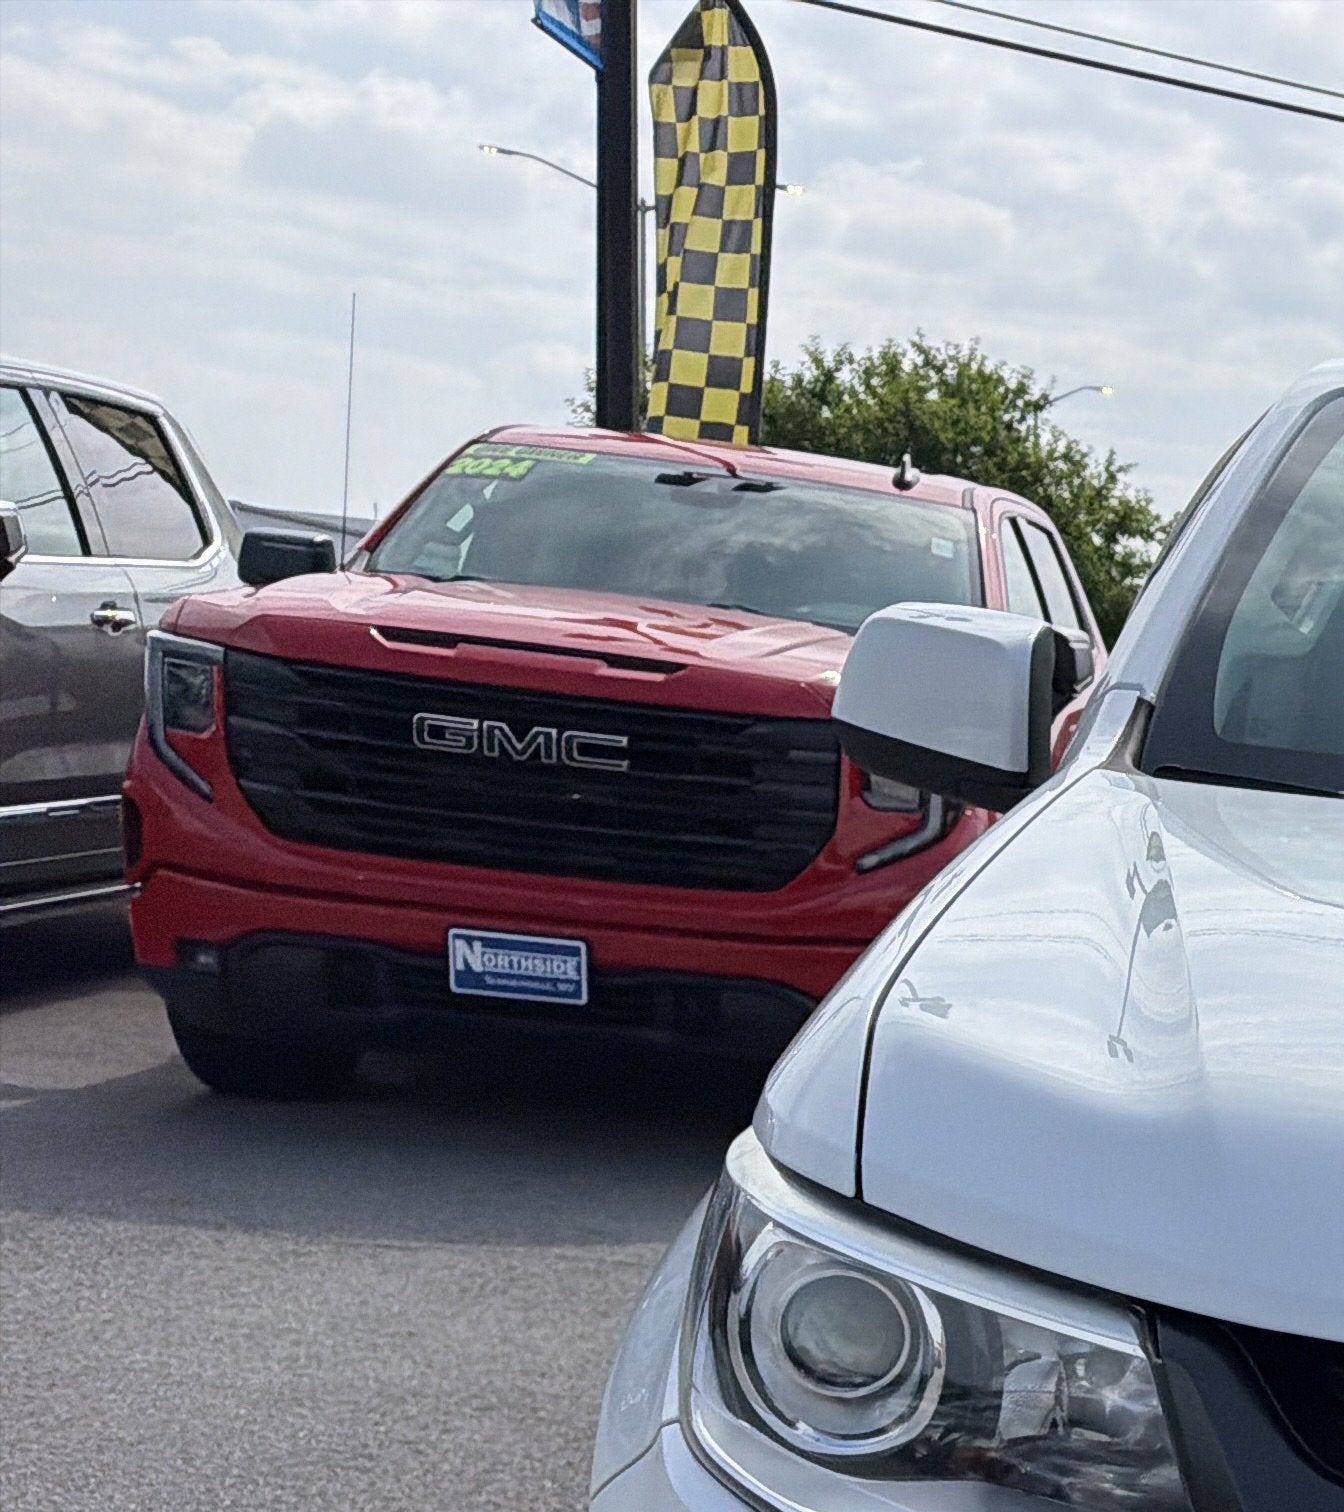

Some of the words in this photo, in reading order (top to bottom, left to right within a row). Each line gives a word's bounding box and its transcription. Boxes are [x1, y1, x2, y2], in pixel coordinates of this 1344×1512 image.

[445, 457, 537, 479] 2024
[411, 712, 630, 772] GMC
[454, 938, 581, 977] NORTHSIDE
